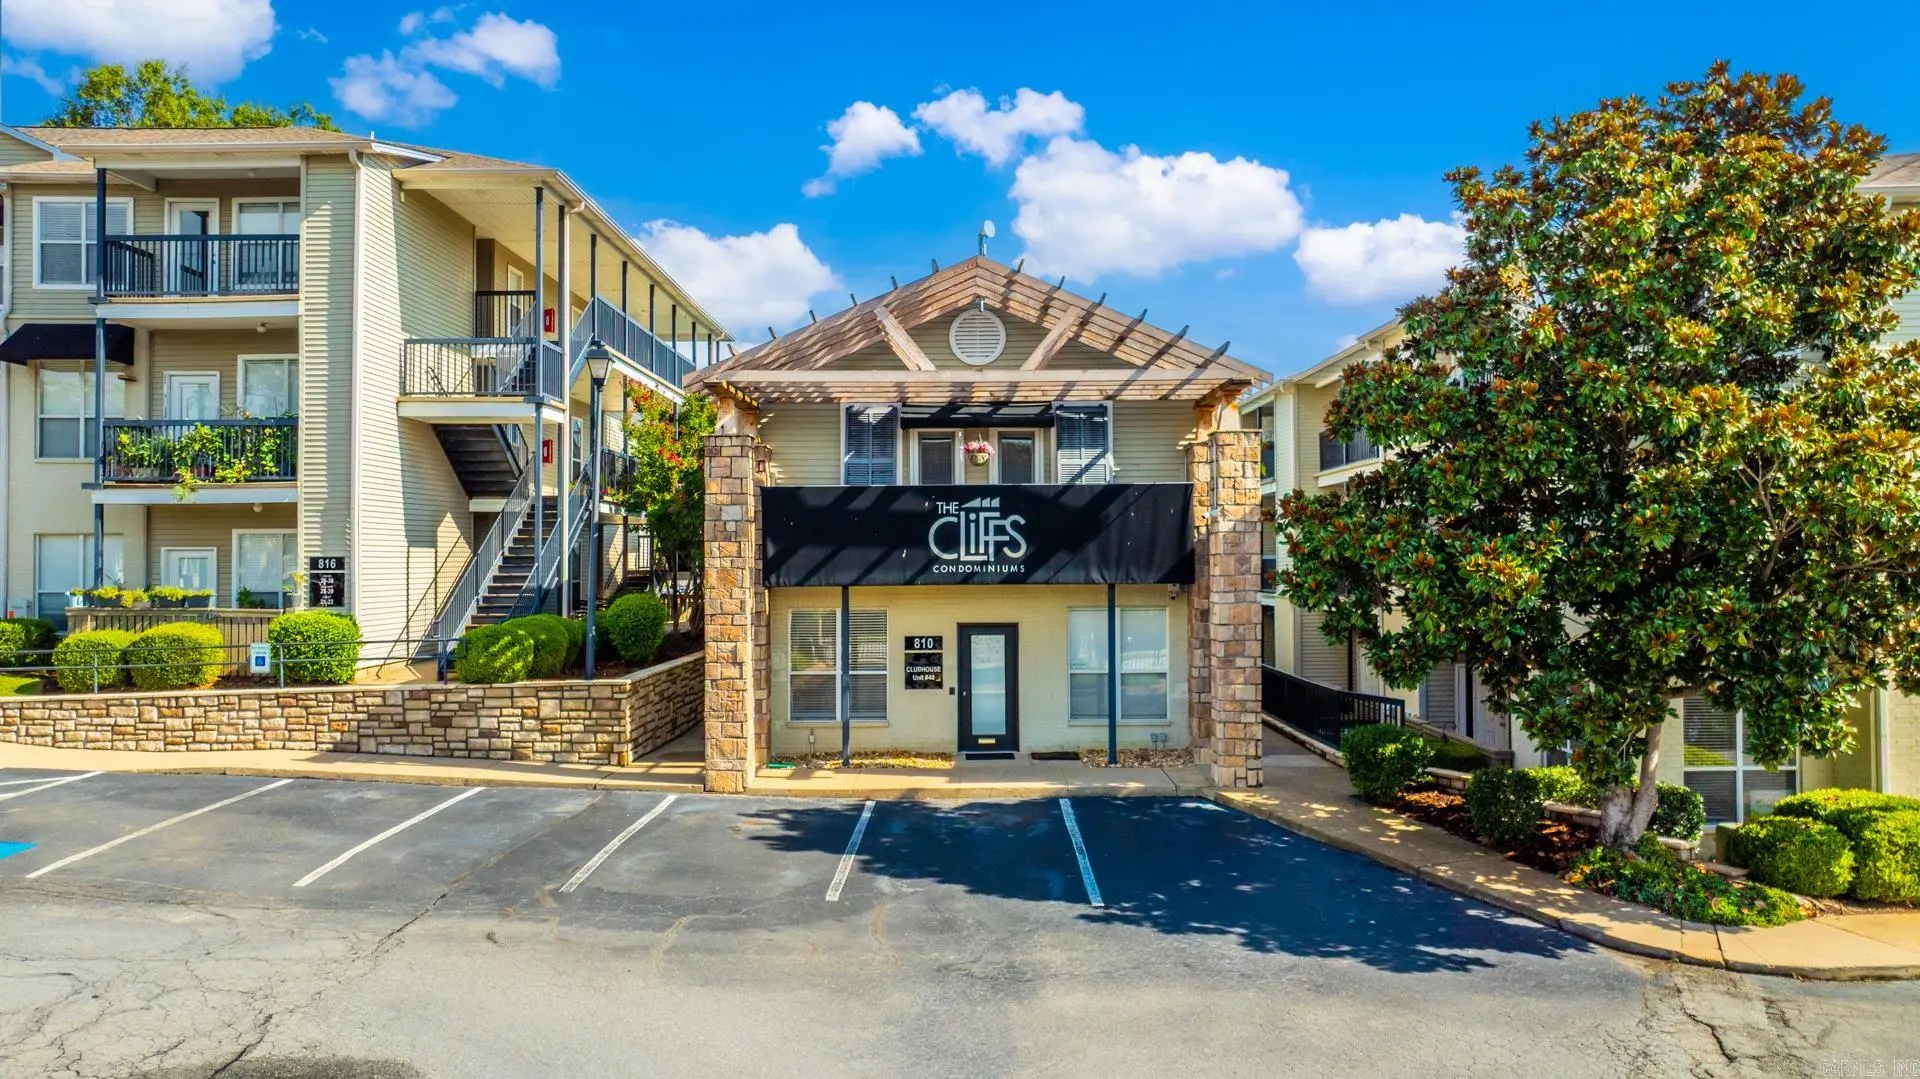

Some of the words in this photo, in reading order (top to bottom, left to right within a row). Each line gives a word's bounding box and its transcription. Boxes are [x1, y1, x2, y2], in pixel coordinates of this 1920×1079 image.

[936, 501, 959, 514] THE
[318, 558, 337, 569] 816
[933, 564, 1025, 573] CONDOMINIUMS
[914, 637, 934, 649] 810
[906, 665, 942, 673] CLUBHOUSE
